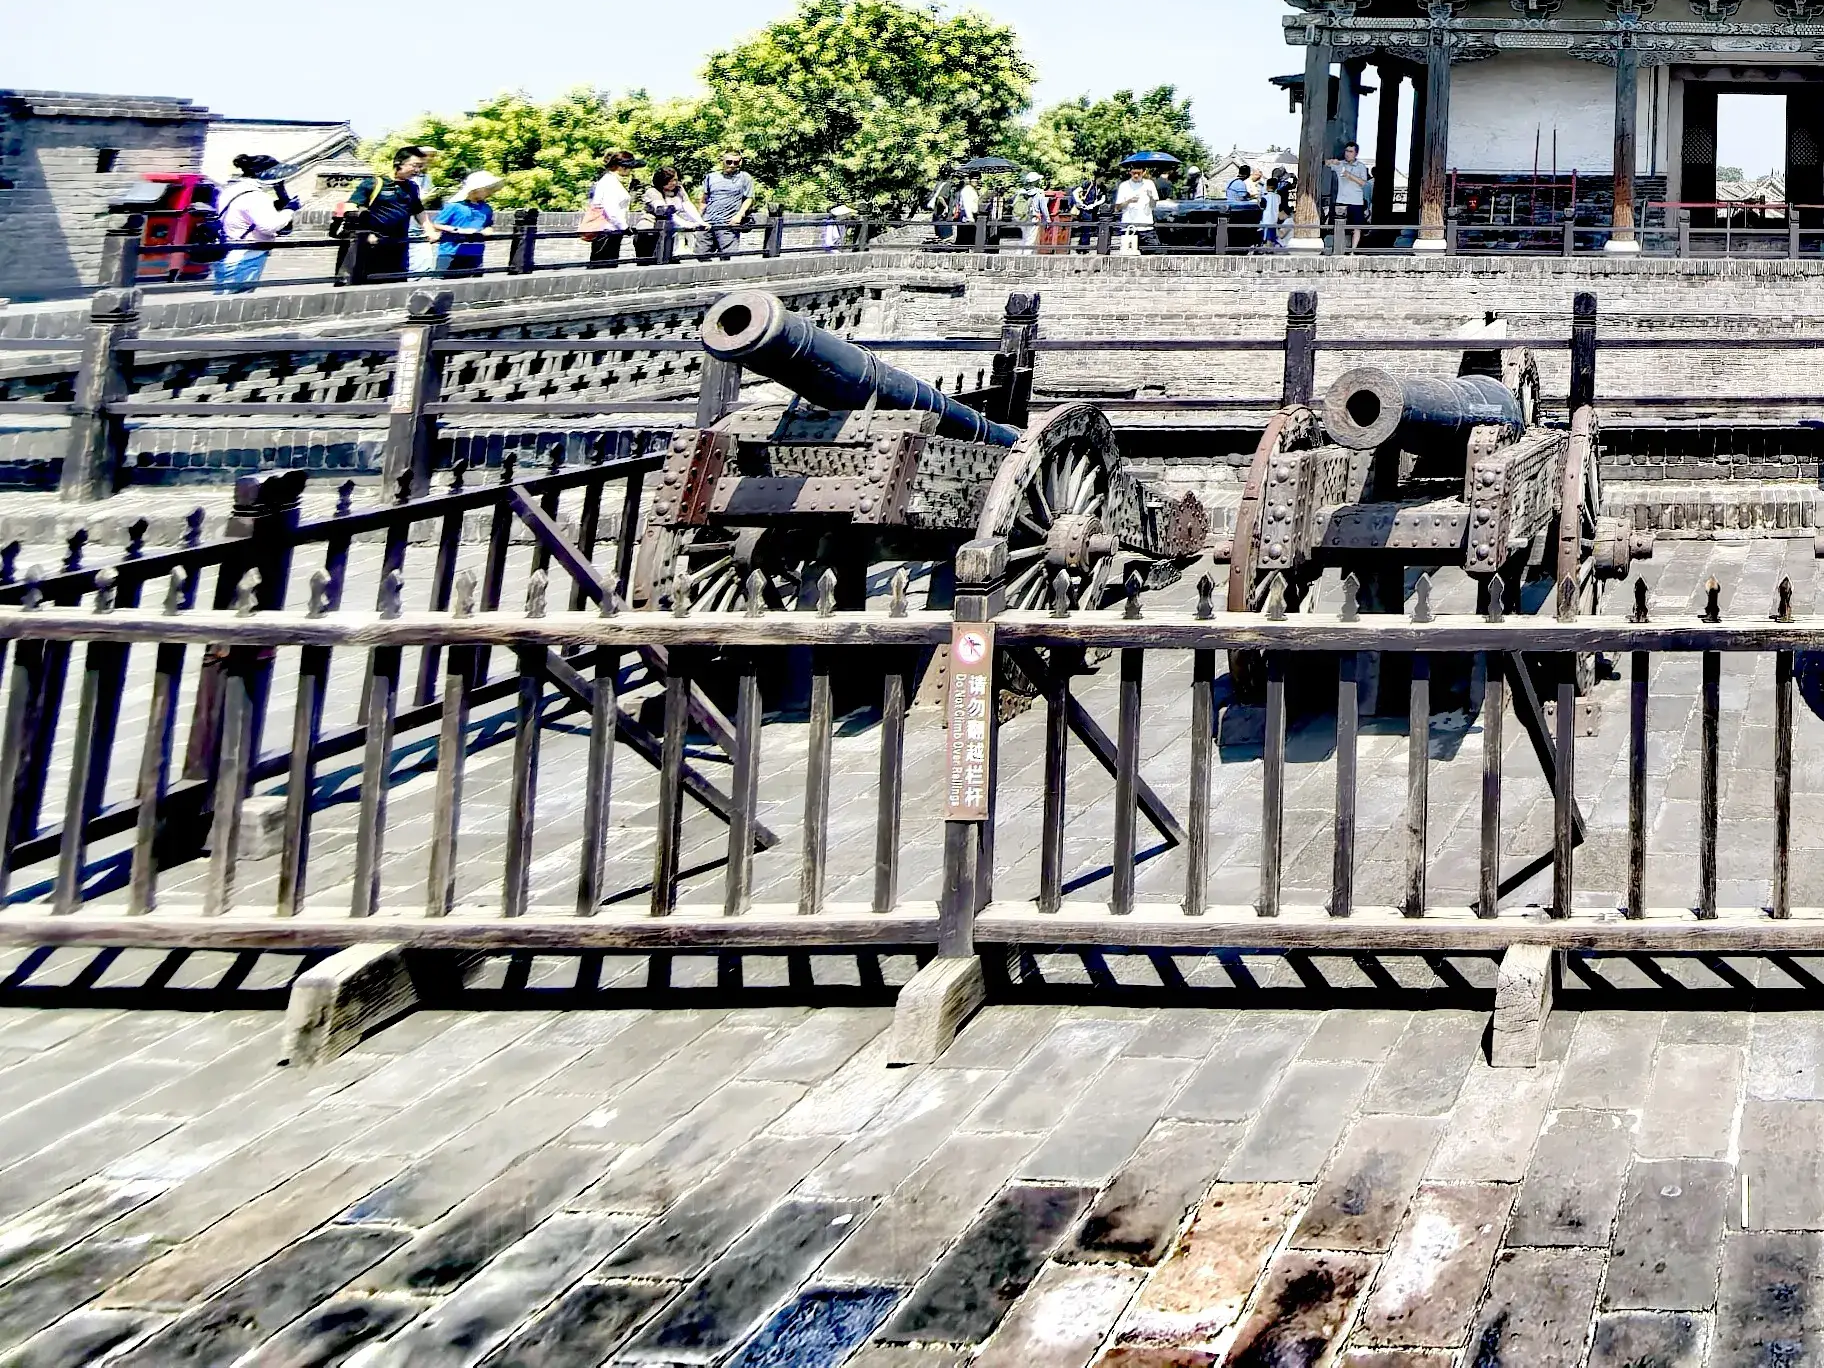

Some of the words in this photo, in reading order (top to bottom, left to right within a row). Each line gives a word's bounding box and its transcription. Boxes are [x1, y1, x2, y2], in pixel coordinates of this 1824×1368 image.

[955, 673, 967, 688] Do
[954, 689, 966, 709] Not
[953, 710, 965, 739] Climb
[952, 741, 964, 765] Over
[965, 674, 988, 808] 请勿翻越栏杆
